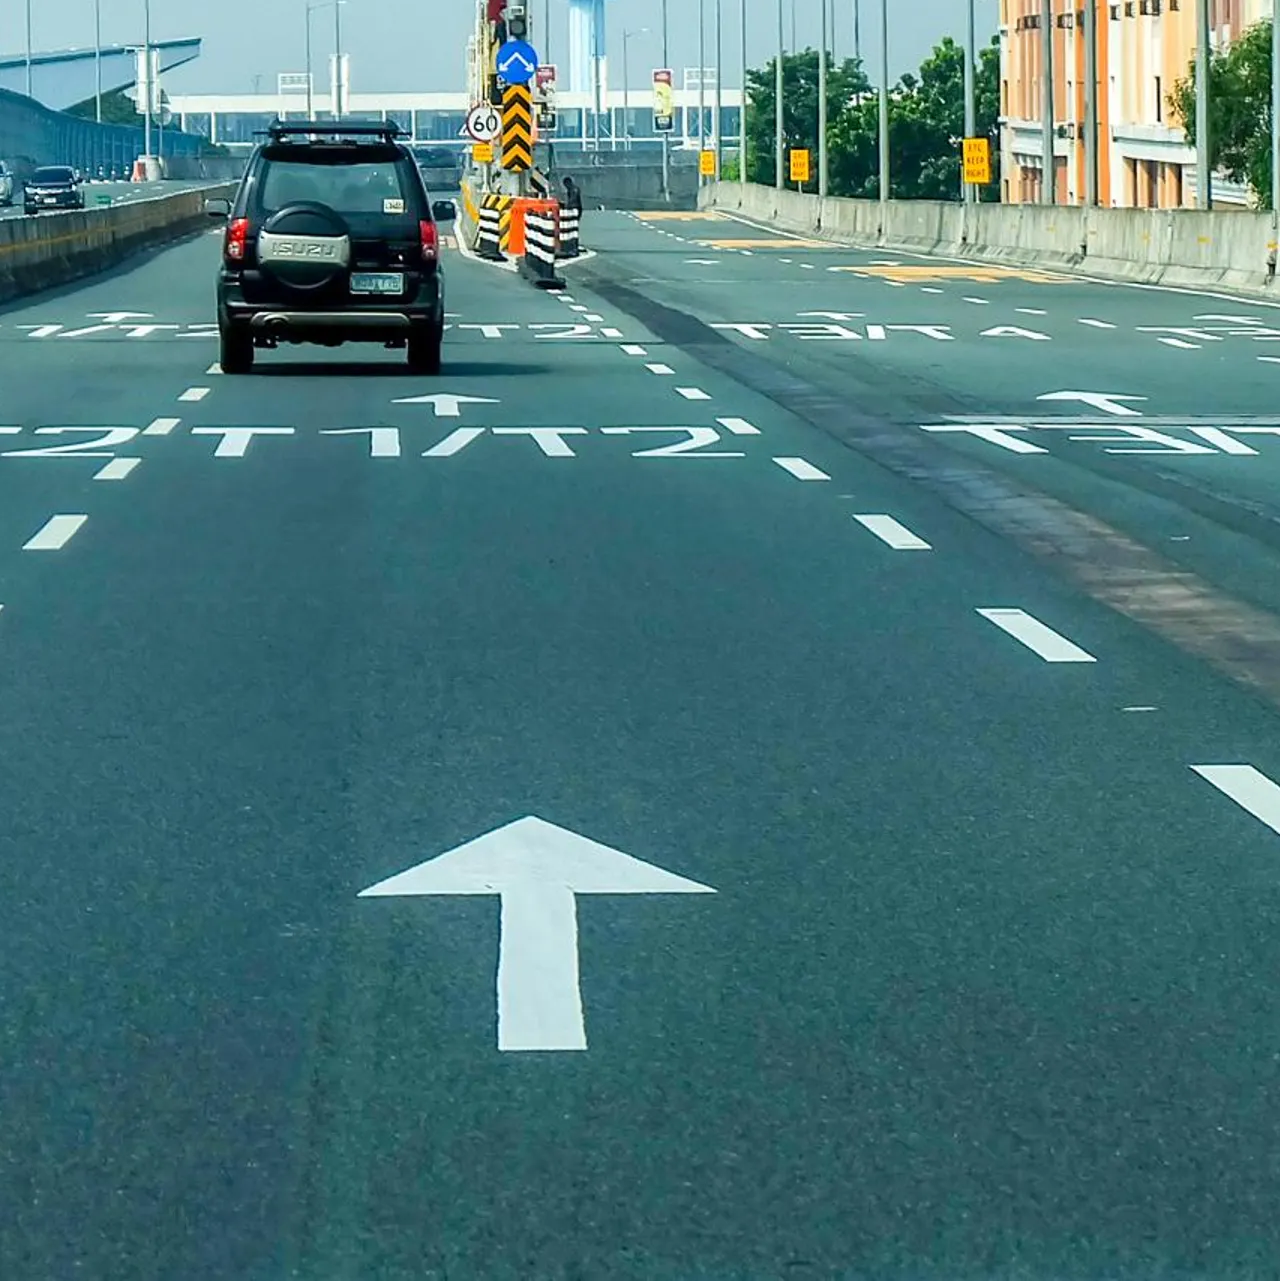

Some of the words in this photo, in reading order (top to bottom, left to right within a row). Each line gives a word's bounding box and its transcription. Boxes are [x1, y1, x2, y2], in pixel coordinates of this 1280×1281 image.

[473, 114, 499, 133] 60
[271, 241, 336, 258] ISUZU
[190, 426, 746, 457] T1/T2
